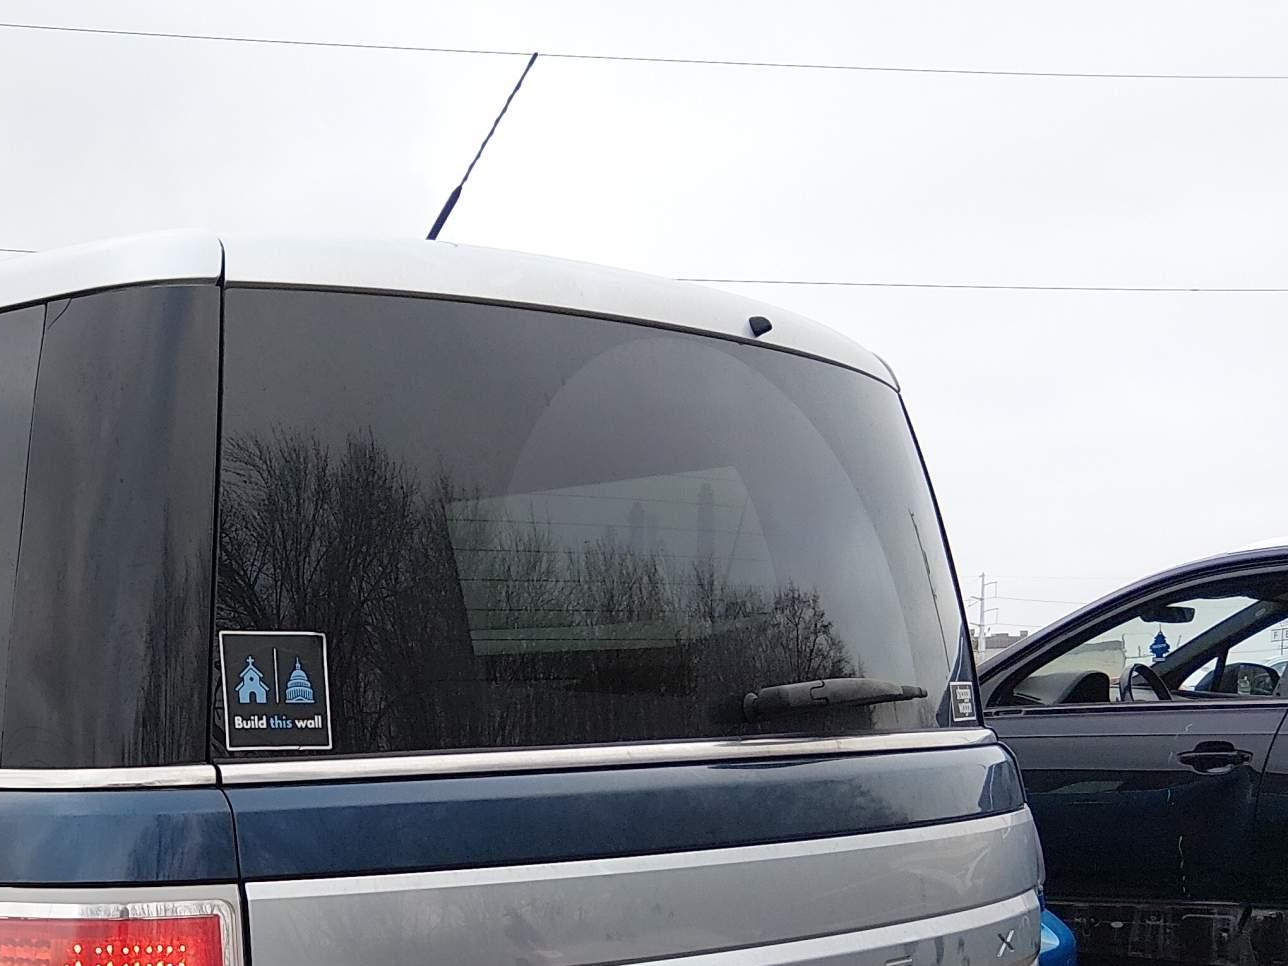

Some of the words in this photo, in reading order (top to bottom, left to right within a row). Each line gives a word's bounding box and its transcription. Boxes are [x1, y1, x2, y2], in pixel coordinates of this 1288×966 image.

[234, 715, 267, 729] Build
[270, 715, 293, 729] this
[295, 715, 322, 729] wall
